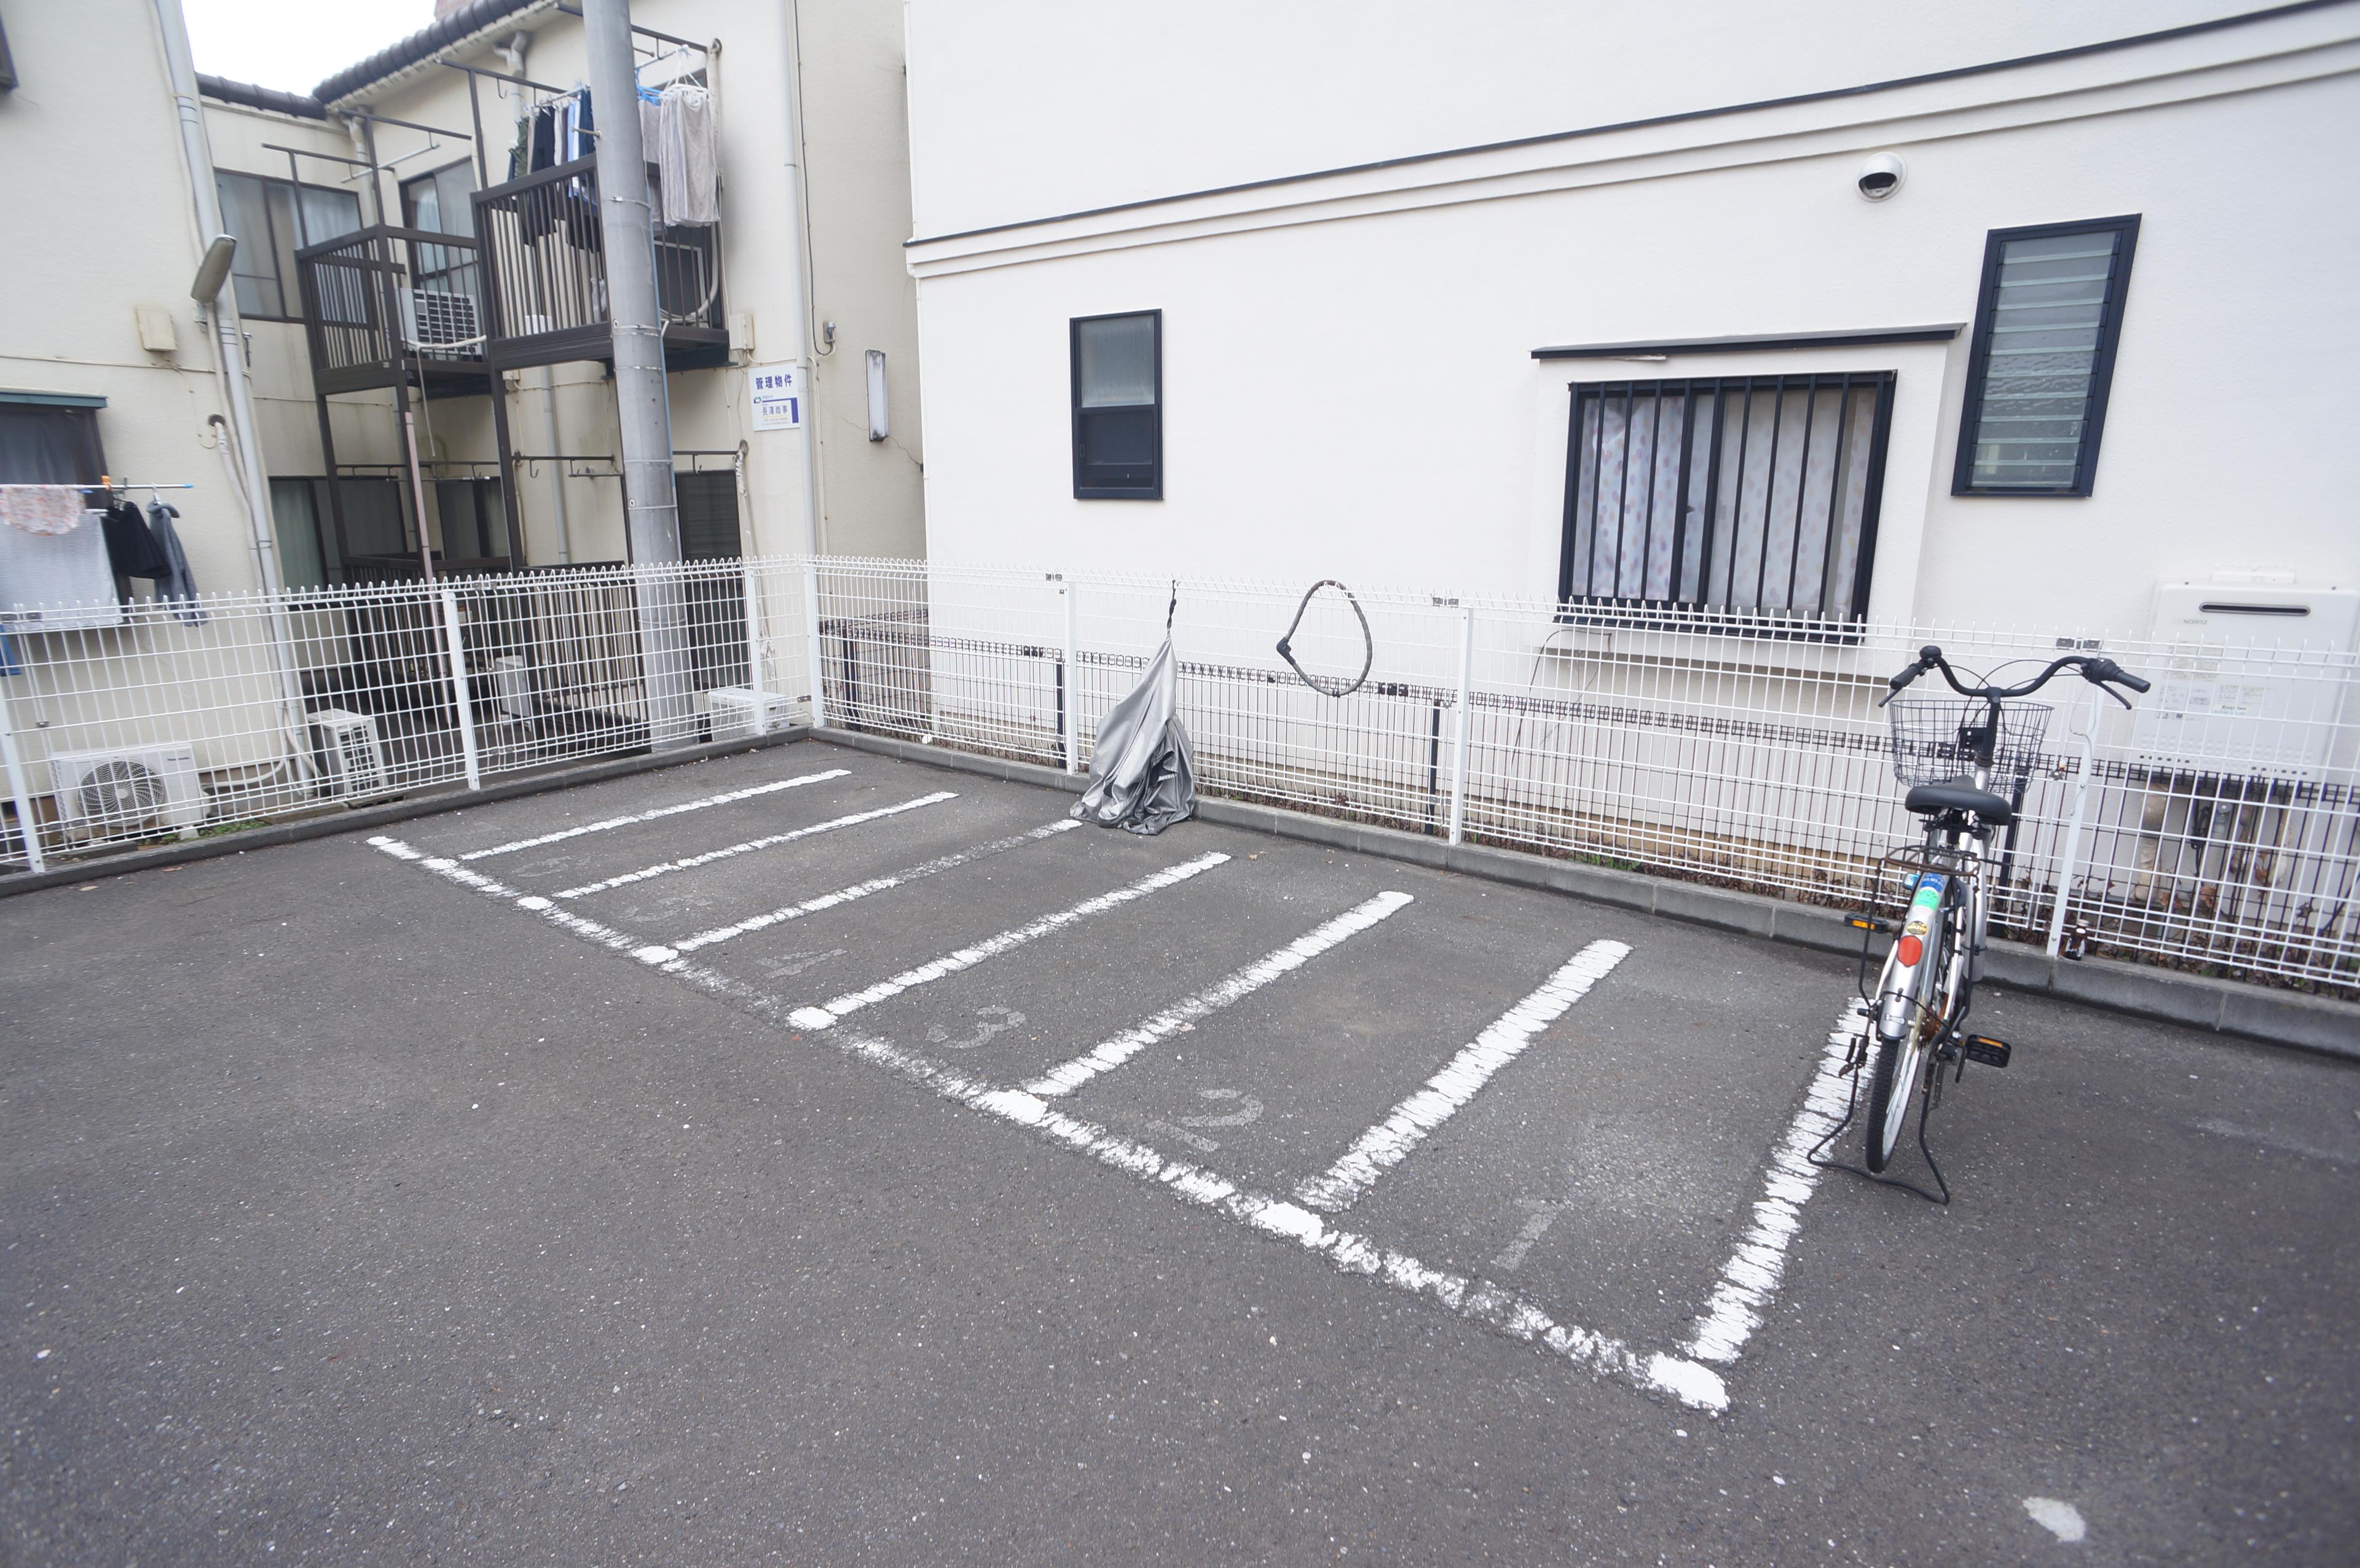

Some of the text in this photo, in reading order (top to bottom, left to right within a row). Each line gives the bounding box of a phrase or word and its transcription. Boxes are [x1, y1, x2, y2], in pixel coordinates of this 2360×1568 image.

[756, 374, 792, 390] 管理物件
[928, 1005, 1027, 1050] 3
[1144, 1087, 1265, 1153] 2
